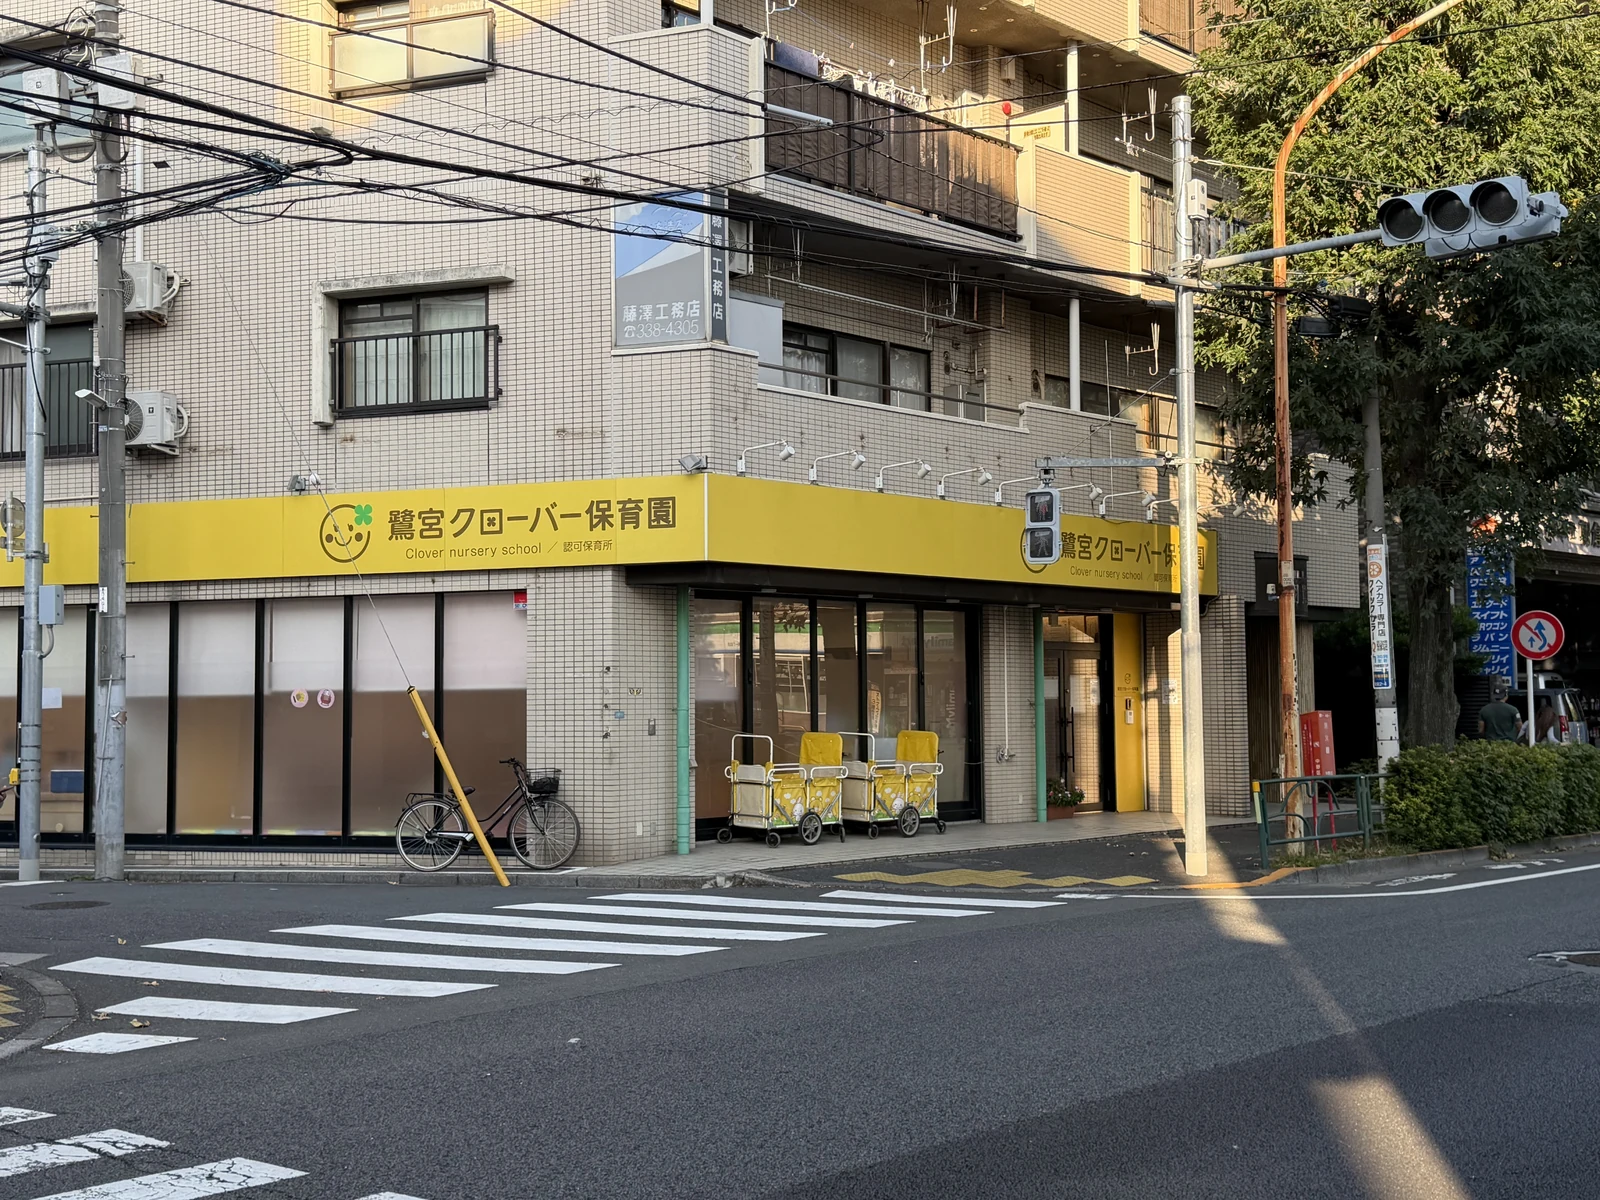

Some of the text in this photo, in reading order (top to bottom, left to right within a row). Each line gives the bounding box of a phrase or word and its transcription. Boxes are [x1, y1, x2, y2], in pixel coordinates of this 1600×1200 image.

[622, 300, 700, 322] 藤澤工務店
[636, 319, 699, 338] 338-4305
[387, 496, 676, 541] 鷺宮クローバー保育園
[405, 547, 444, 559] Clover
[449, 546, 497, 558] nursery
[502, 542, 541, 556] school
[563, 539, 613, 553] 認可保育所
[1070, 565, 1092, 576] Clover
[1094, 567, 1120, 580] nursery
[1121, 567, 1143, 581] school
[1471, 610, 1508, 620] スイフト
[1479, 622, 1508, 631] Rワゴン
[1472, 643, 1510, 653] ジムニー
[1483, 665, 1509, 675] ャリイ
